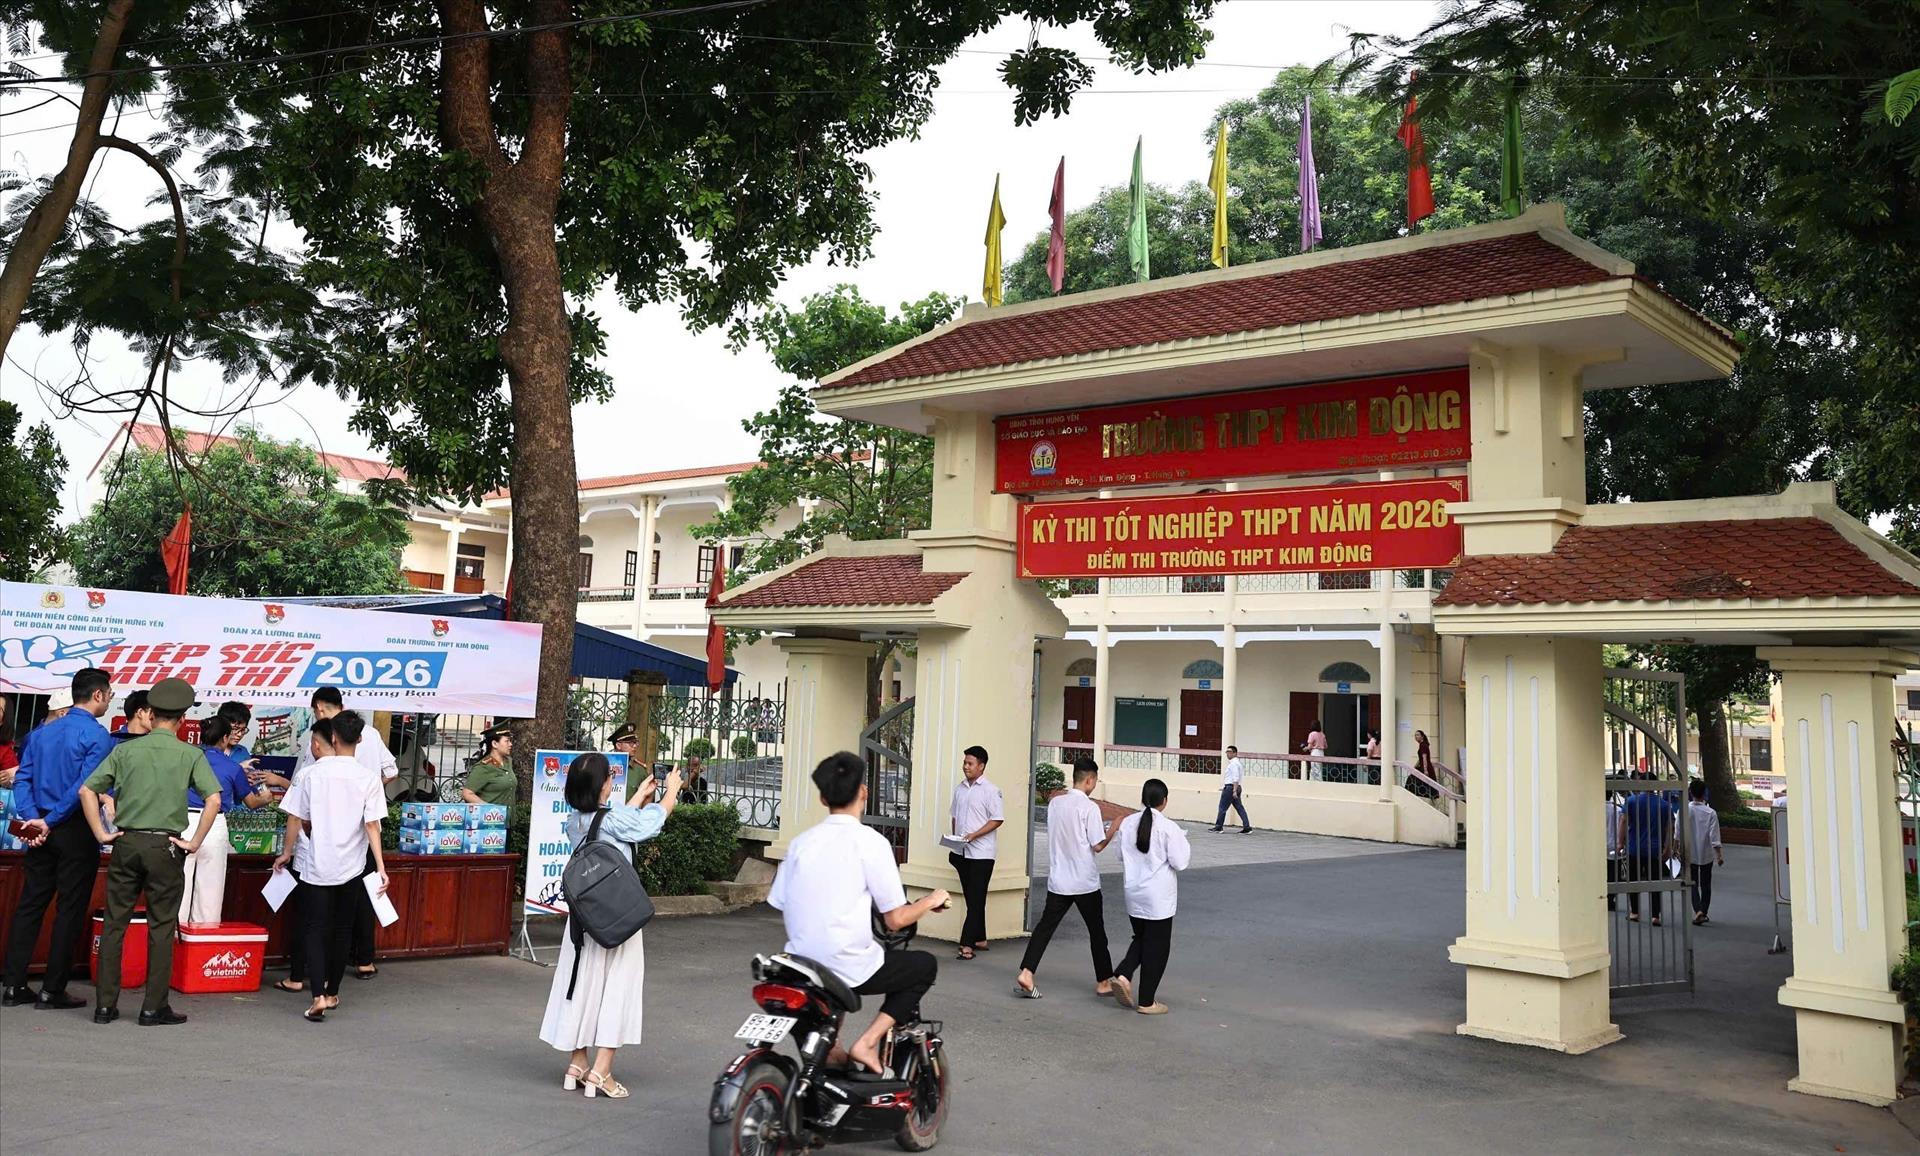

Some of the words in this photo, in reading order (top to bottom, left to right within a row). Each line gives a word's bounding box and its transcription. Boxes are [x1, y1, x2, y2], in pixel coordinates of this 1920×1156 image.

[1102, 410, 1204, 458] TRƯỜNG
[1216, 407, 1286, 448] THPT
[1297, 400, 1358, 441] KIM
[1369, 385, 1461, 442] ĐỘNG
[1032, 514, 1058, 543] KỲ
[1064, 517, 1096, 542] THI
[1103, 506, 1141, 542] TỐT
[1148, 506, 1233, 544] NGHIỆP
[1241, 508, 1302, 536] THPT
[1310, 498, 1372, 534] NĂM
[1380, 499, 1448, 530] 2026
[1087, 547, 1126, 570] ĐIỂM
[1131, 552, 1156, 569] THI
[1160, 546, 1226, 568] TRƯỜNG
[1232, 548, 1274, 566] THPT
[1279, 546, 1314, 564] KIM
[1320, 542, 1372, 567] ĐỘNG
[14, 620, 28, 628] CHI
[16, 610, 42, 619] THANH
[45, 612, 64, 620] NIÊN
[66, 614, 89, 622] CÔNG
[125, 618, 146, 626] HƯNG
[149, 619, 164, 628] YÊN
[102, 642, 210, 664] TIẾP
[220, 641, 314, 664] SỨC
[438, 640, 454, 648] THPT
[101, 664, 202, 686] MÙA
[216, 667, 295, 687] THI
[316, 656, 432, 686] 2026
[356, 688, 400, 698] Cùng
[405, 690, 436, 698] Bạn
[552, 798, 572, 813] BÌN
[539, 840, 572, 856] HOÀN
[542, 860, 564, 877] TỐT
